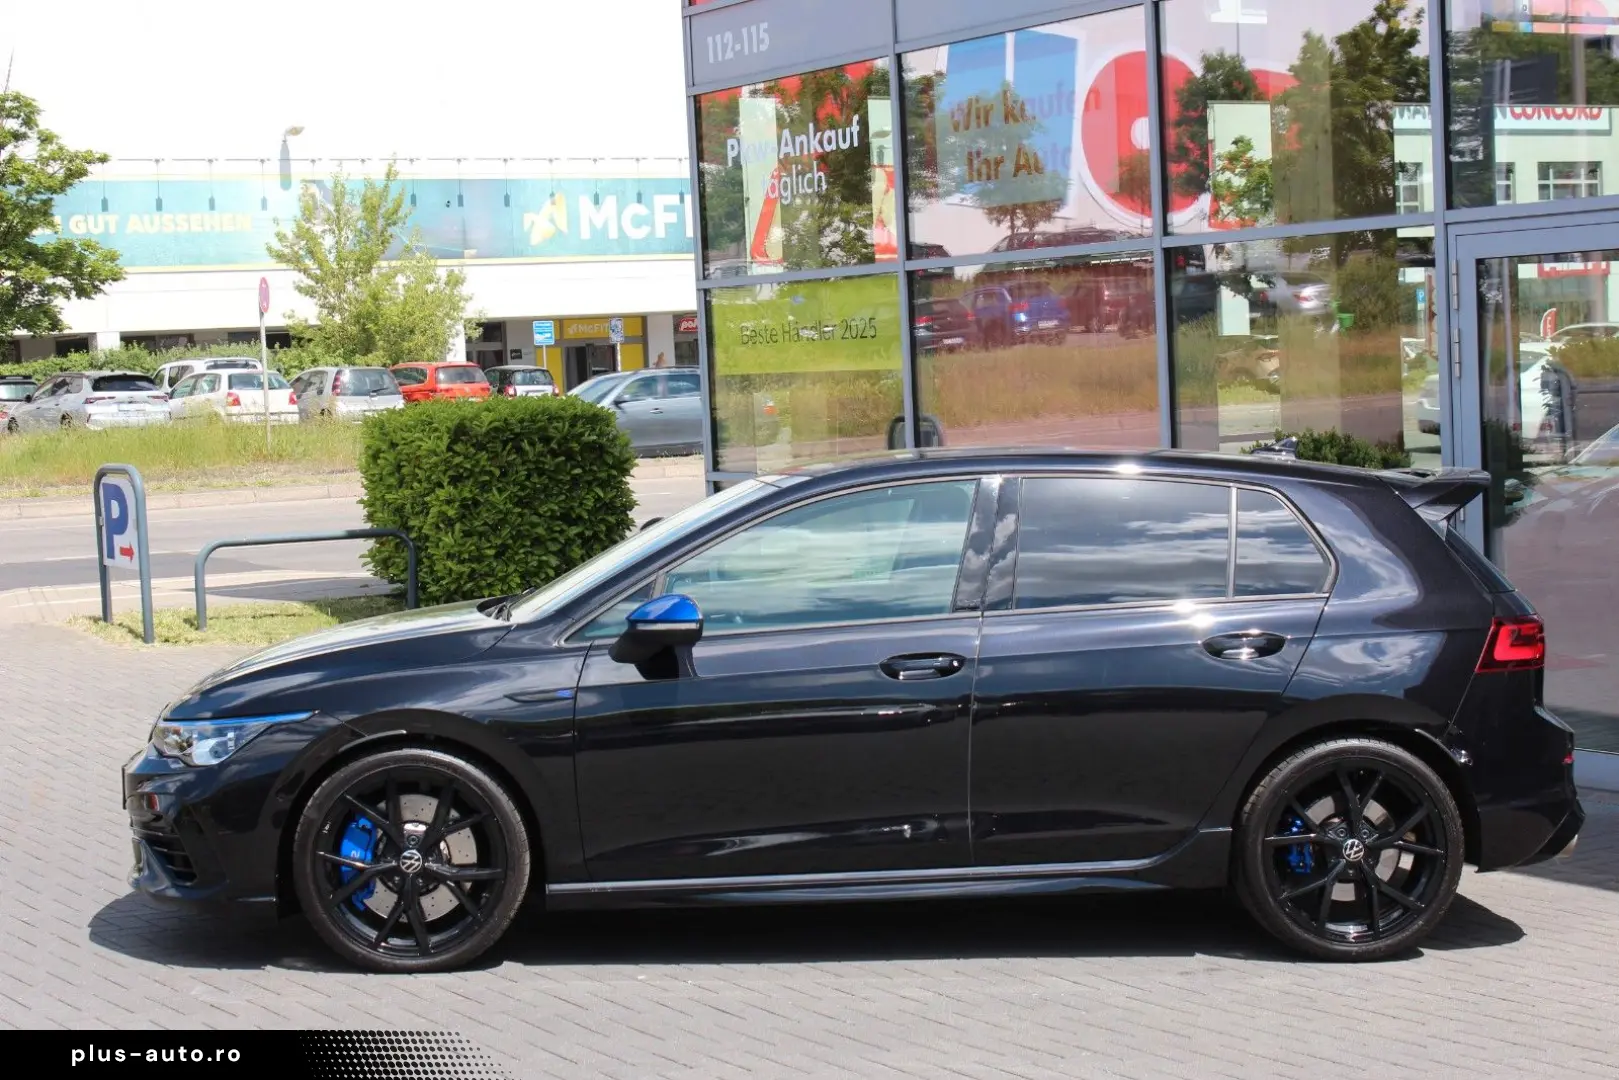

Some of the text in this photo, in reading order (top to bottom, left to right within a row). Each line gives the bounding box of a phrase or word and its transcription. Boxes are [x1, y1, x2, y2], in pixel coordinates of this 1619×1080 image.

[706, 22, 770, 63] 112-115
[949, 95, 995, 132] Wir
[966, 147, 1005, 182] Ihr
[68, 214, 120, 236] GUT
[125, 213, 253, 234] AUSSEHEN
[739, 324, 779, 345] Beste
[840, 317, 877, 340] 2025
[102, 483, 129, 560] P
